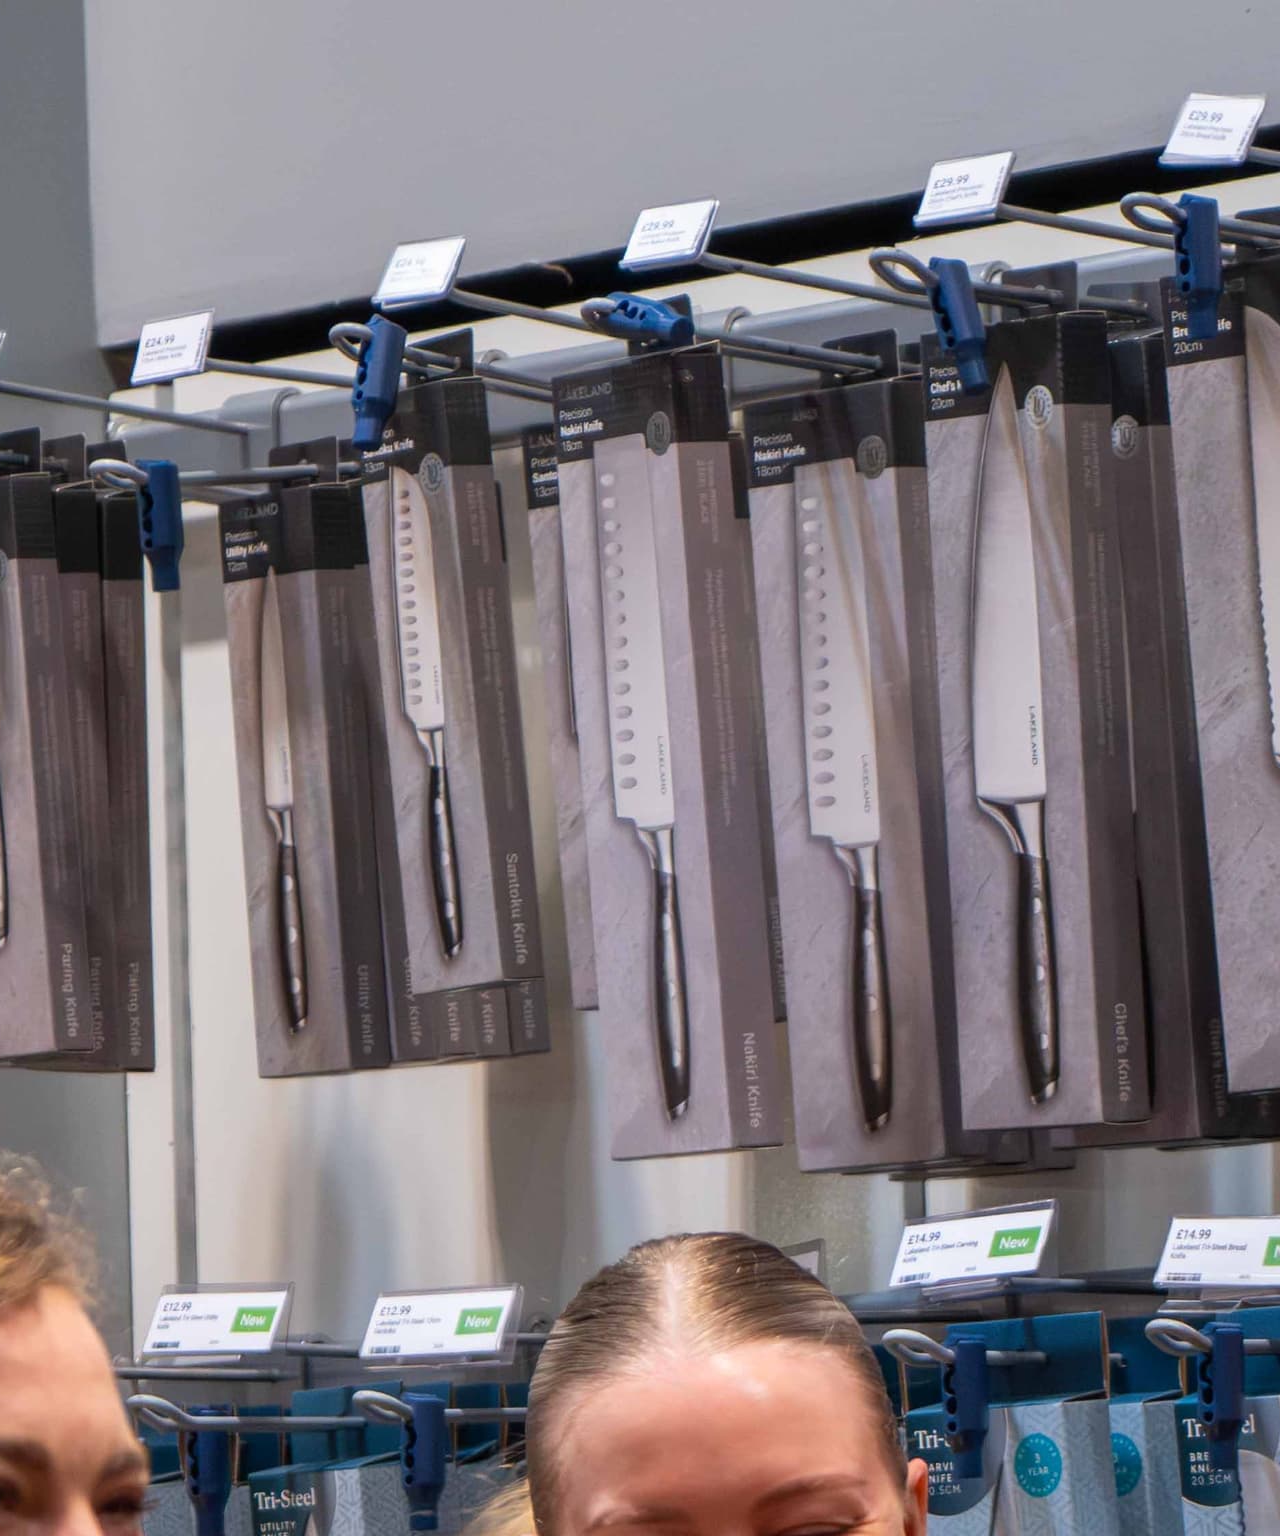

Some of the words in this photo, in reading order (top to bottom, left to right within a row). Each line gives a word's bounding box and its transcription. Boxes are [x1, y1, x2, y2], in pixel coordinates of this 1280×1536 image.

[1188, 110, 1223, 123] £29.99
[933, 174, 970, 189] £29.99
[144, 334, 175, 348] £24.99
[1173, 341, 1204, 354] 20cm
[930, 380, 954, 395] Chef's
[560, 407, 593, 420] Precision
[560, 423, 583, 437] Nakiri
[583, 420, 604, 433] Knife
[753, 432, 792, 447] Precision
[754, 449, 782, 463] Nakiri
[783, 444, 806, 458] Knife
[248, 543, 268, 555] Knife
[1028, 705, 1039, 766] LAKELAND
[506, 853, 522, 919] Santoku
[512, 922, 528, 965] Knife
[61, 942, 74, 993] Paring
[64, 997, 79, 1038] Knife
[361, 1012, 375, 1055] Knife
[1113, 1002, 1128, 1052] Chef's
[742, 1031, 757, 1080] Nakiri
[1118, 1055, 1133, 1104] Knife
[747, 1085, 760, 1129] Knife
[907, 1231, 941, 1245] £14.99
[1176, 1228, 1211, 1240] £14.99
[999, 1236, 1029, 1249] New
[163, 1301, 193, 1312] £12.99
[379, 1305, 412, 1316] £12.99
[240, 1313, 267, 1327] New
[464, 1314, 492, 1328] New
[1034, 1452, 1041, 1464] 3
[928, 1473, 952, 1483] NIFE
[1028, 1466, 1049, 1477] YEAR
[1191, 1473, 1233, 1486] 20.5CM
[254, 1487, 316, 1511] Tri-Steel
[260, 1521, 296, 1533] UTILITY
